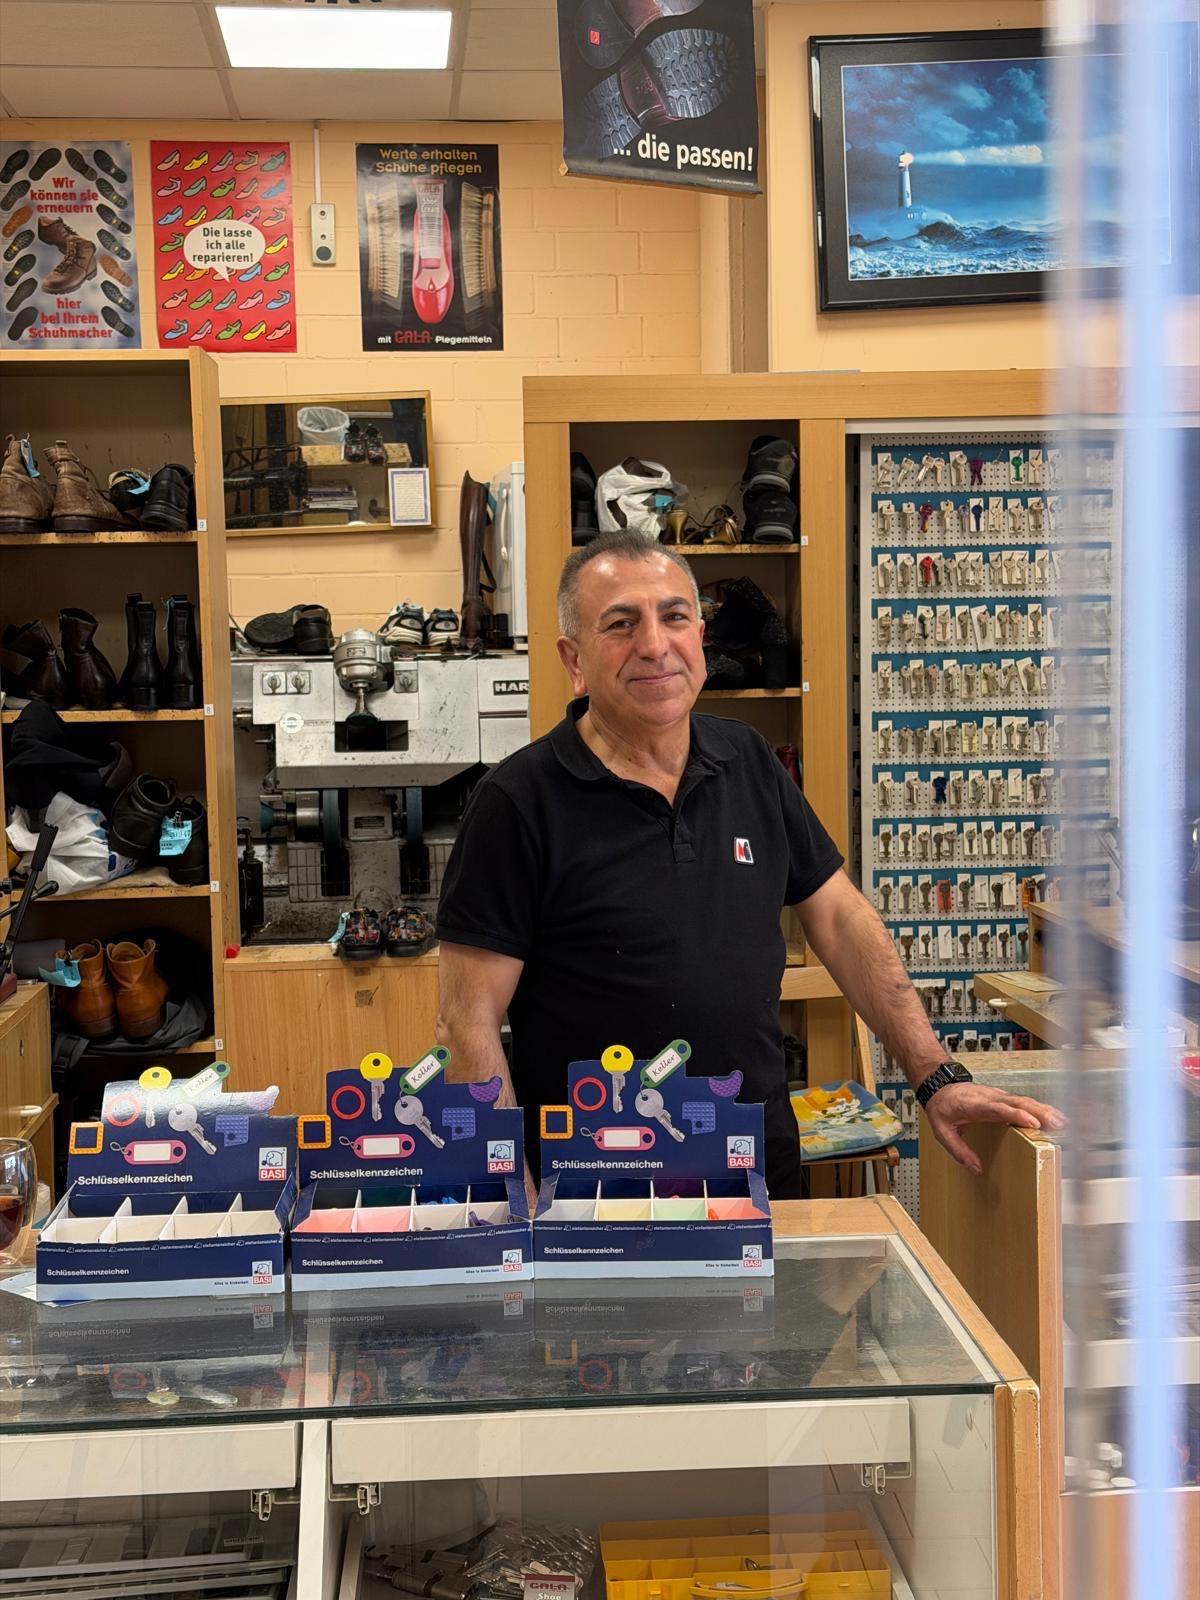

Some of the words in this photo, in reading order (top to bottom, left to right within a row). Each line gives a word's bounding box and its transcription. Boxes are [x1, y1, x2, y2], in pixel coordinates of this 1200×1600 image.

[379, 149, 418, 160] Werte
[421, 149, 478, 160] erhalten
[637, 132, 671, 162] die
[676, 144, 754, 171] passen!
[376, 162, 427, 173] Schuhe
[430, 162, 482, 175] pflegen
[52, 177, 75, 189] Wir
[30, 189, 77, 201] können
[79, 189, 99, 201] sie
[36, 204, 94, 213] erneuern
[202, 227, 221, 237] Die
[223, 227, 253, 237] lasse
[206, 240, 222, 250] ich
[225, 240, 246, 250] alle
[192, 252, 254, 264] reparieren!
[56, 297, 82, 309] hier
[40, 312, 61, 324] bei
[63, 312, 99, 324] Ihrem
[28, 327, 113, 339] Schuhmacher
[377, 335, 392, 344] mit
[394, 330, 431, 344] GALA
[488, 1161, 513, 1173] BASI
[551, 1158, 663, 1170] Schlüsselkennzeichen
[729, 1157, 754, 1168] BASI
[259, 1168, 286, 1180] BASI
[309, 1165, 423, 1180] Schlüsselkennzeichen
[77, 1172, 193, 1186] Schlüsselkennzeichen
[543, 1246, 624, 1255] Schlüsselkennzeichen
[302, 1258, 383, 1267] Schlüsselkennzeichen
[503, 1263, 522, 1272] BASI
[743, 1259, 762, 1268] BASI
[46, 1268, 130, 1277] Schlüsselkennzeichen
[253, 1276, 272, 1284] BASI
